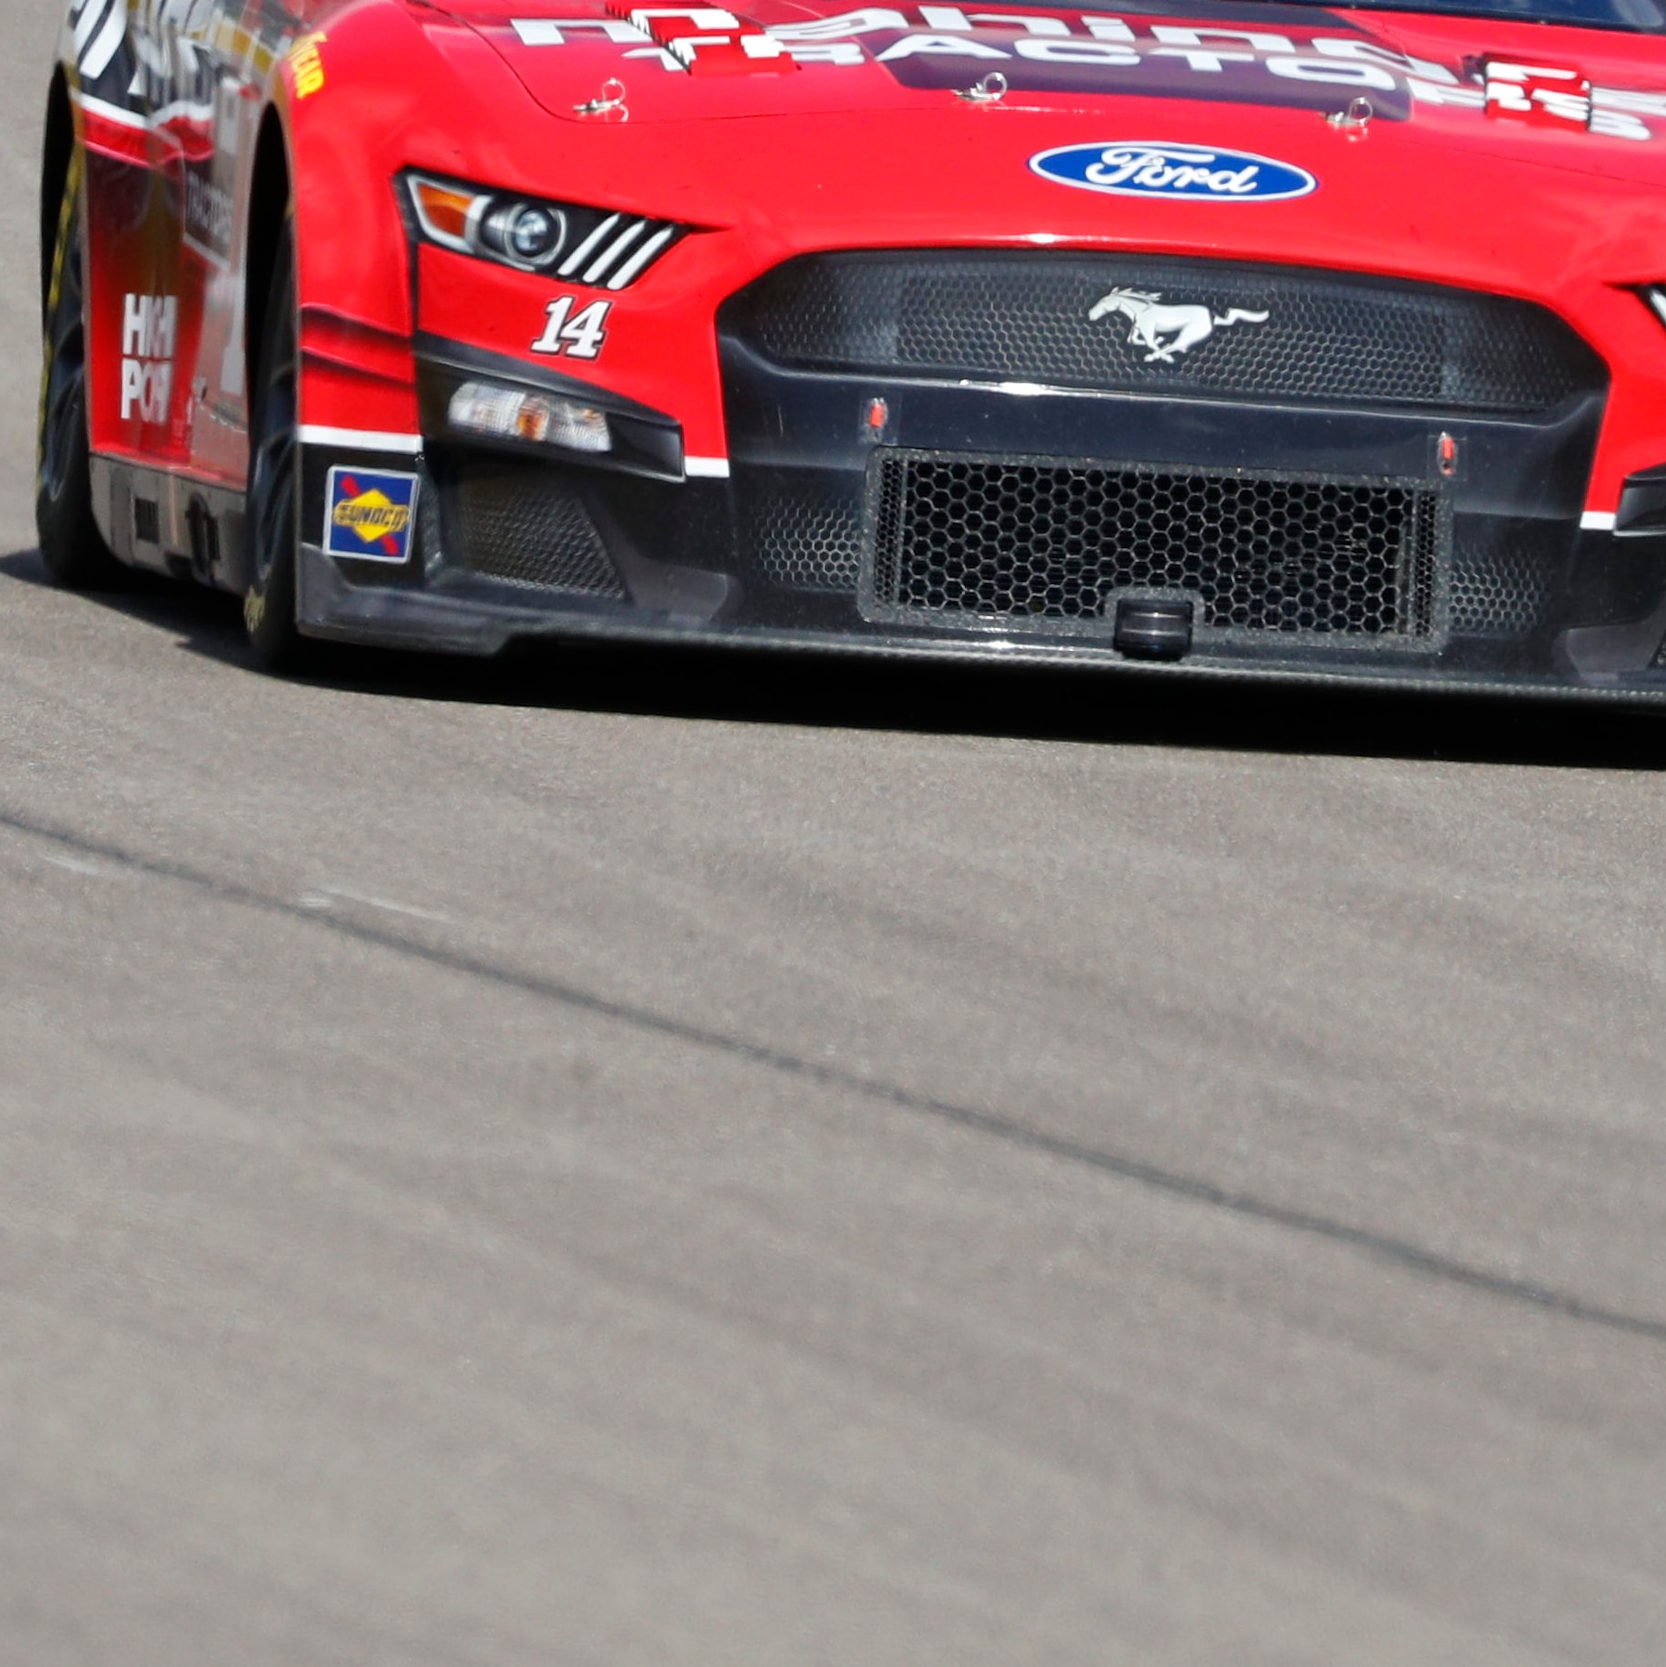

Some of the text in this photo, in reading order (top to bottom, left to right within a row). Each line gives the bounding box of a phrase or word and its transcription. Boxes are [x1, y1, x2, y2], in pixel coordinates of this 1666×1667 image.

[1085, 145, 1260, 194] Ford
[529, 294, 613, 362] 14
[335, 502, 410, 531] SUNOCO
